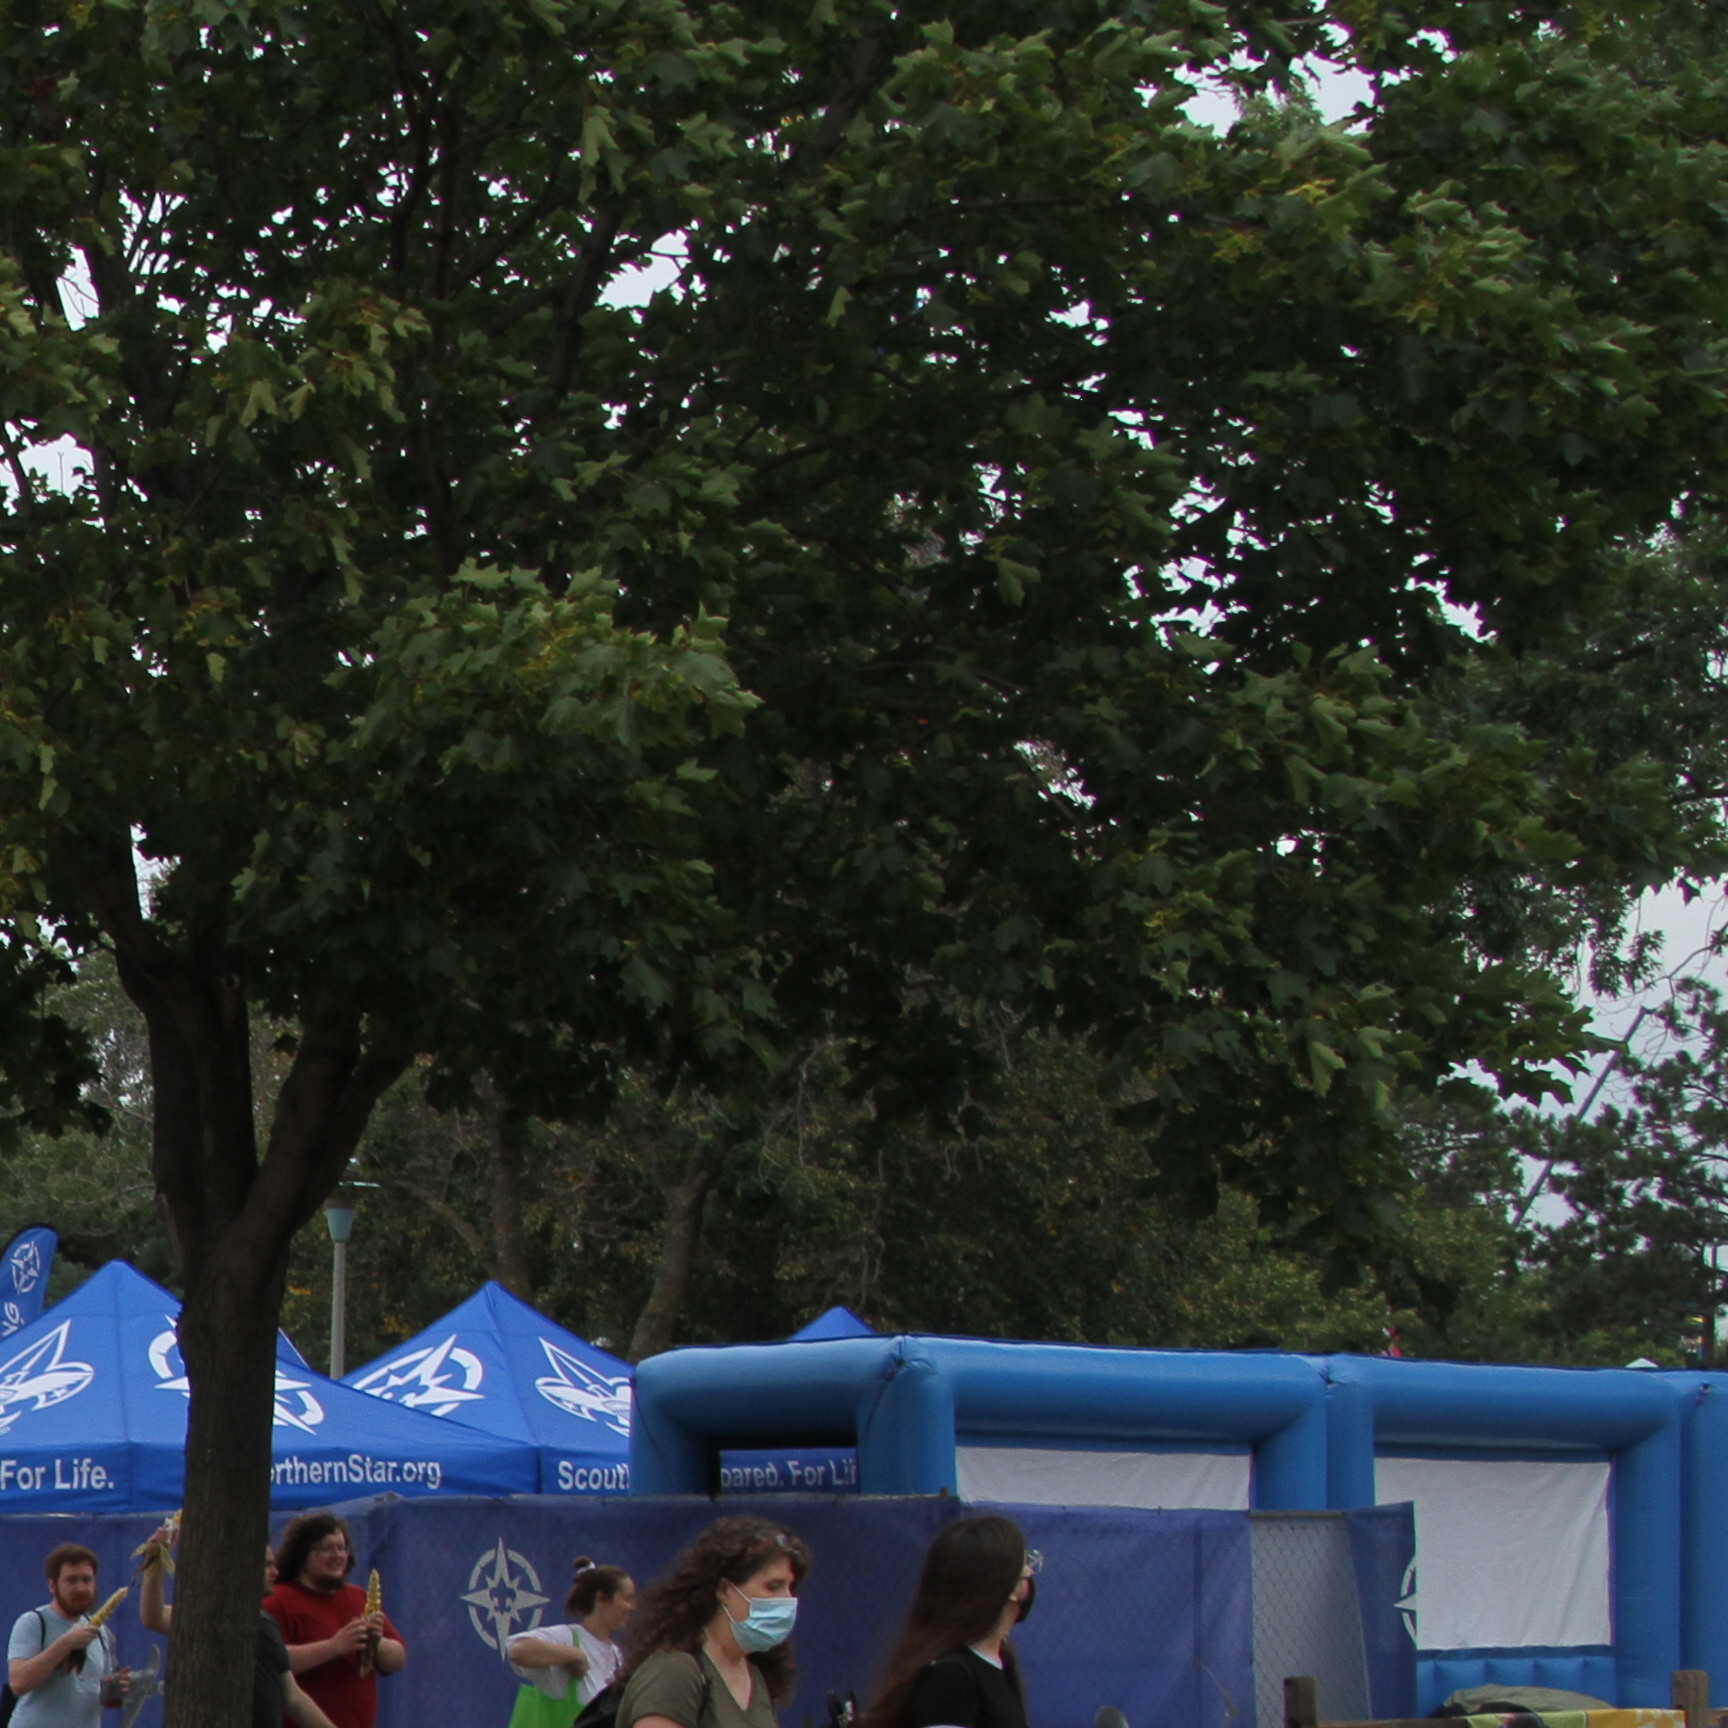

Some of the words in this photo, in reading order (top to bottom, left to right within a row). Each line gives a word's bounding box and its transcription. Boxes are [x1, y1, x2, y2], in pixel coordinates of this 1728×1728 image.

[0, 1459, 46, 1490] For
[54, 1457, 115, 1490] Life.
[271, 1453, 442, 1490] rthernStar.org
[558, 1460, 630, 1490] Scout
[787, 1460, 826, 1486] For
